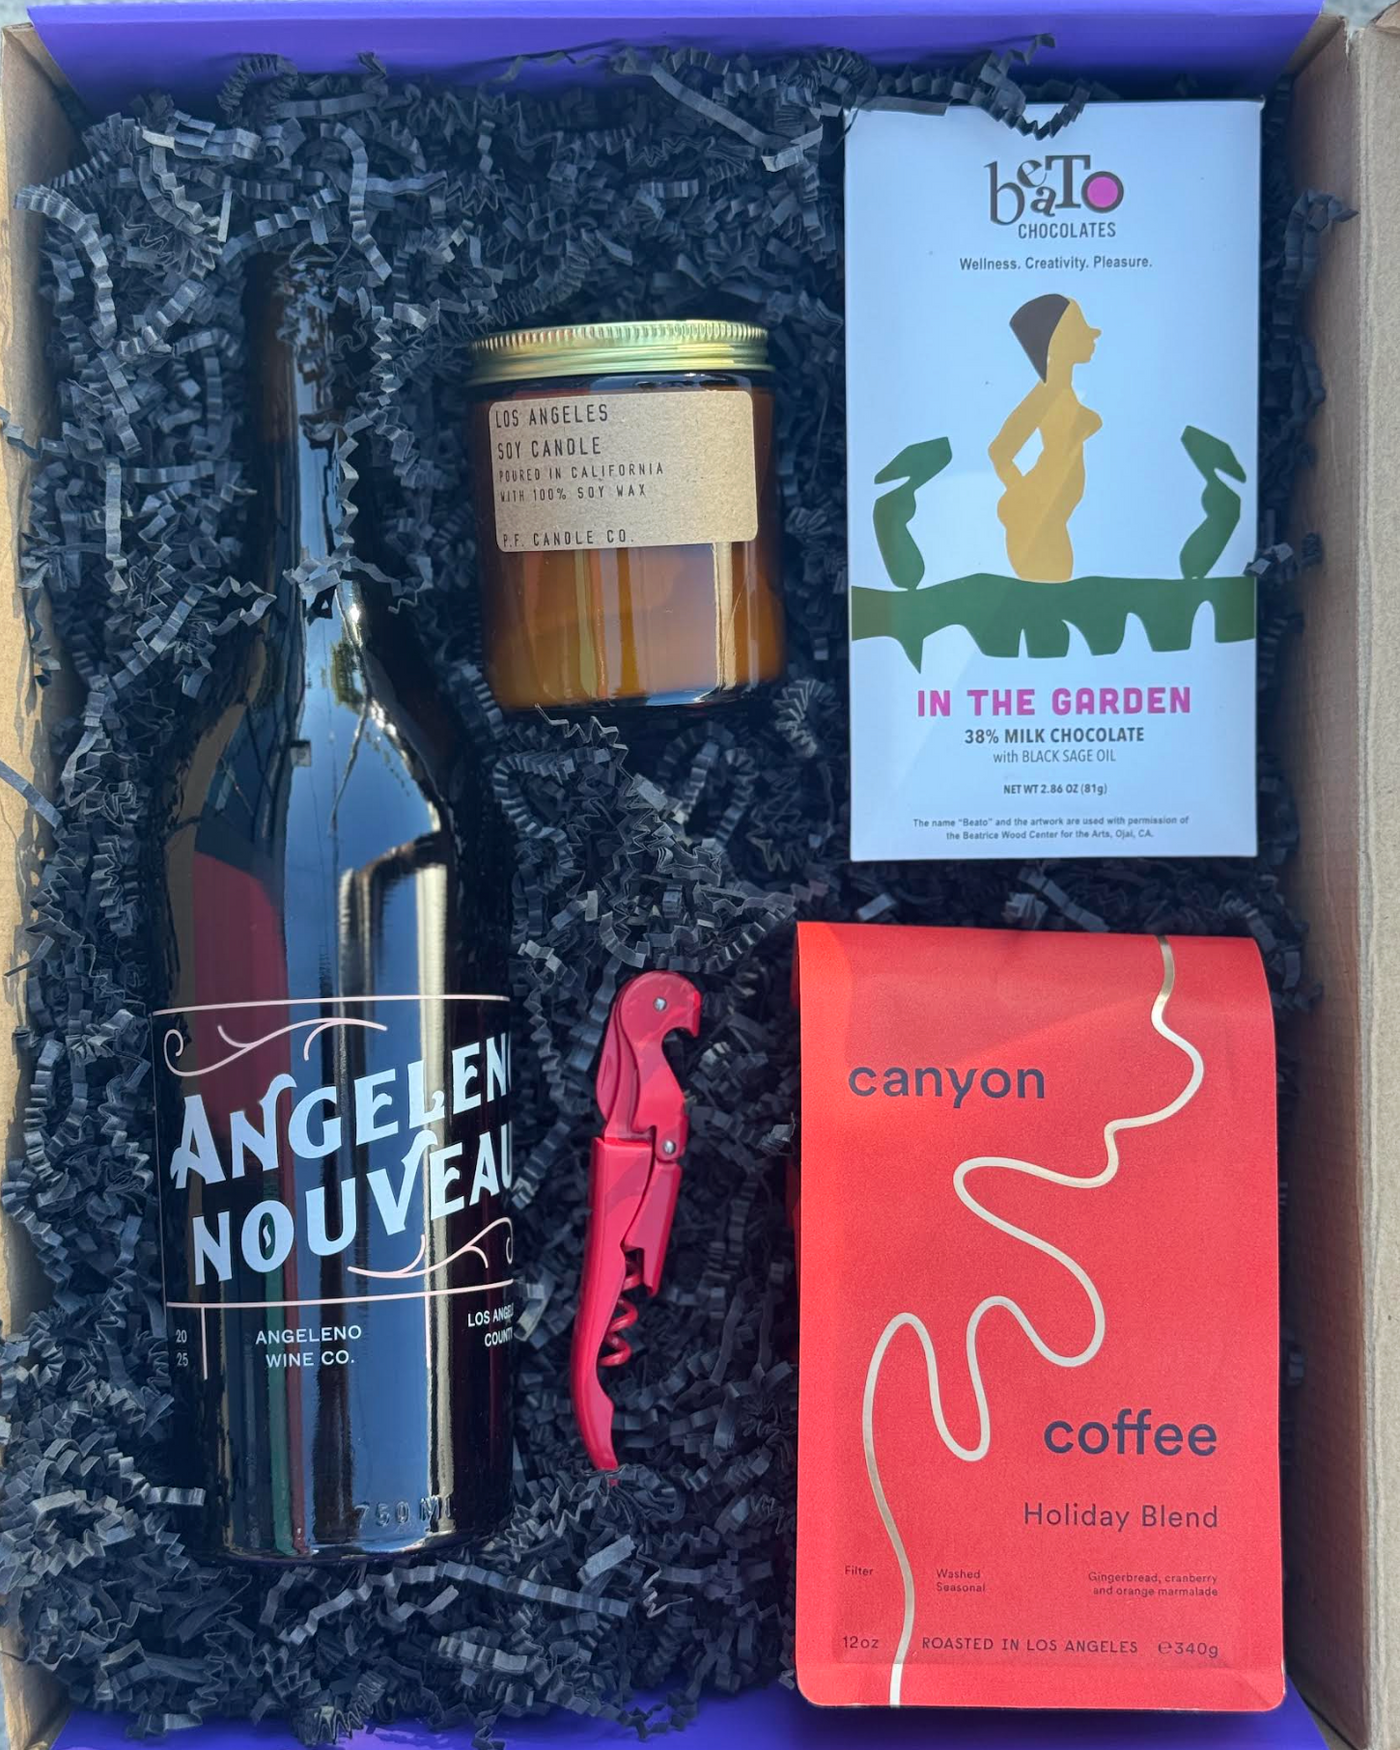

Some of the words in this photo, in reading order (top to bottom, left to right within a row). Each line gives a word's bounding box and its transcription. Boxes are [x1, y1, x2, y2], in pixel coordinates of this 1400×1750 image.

[1018, 222, 1117, 239] CHOCOLATES
[959, 257, 1021, 271] Wellness.
[1025, 256, 1089, 271] Creativity.
[1093, 255, 1153, 269] Pleasure.
[495, 409, 519, 428] LOS
[529, 403, 608, 426] ANGELES
[497, 440, 521, 460] SOY
[531, 436, 601, 458] CANDLE
[499, 469, 541, 482] POURED
[549, 467, 562, 479] IN
[571, 462, 664, 479] CALIFORNIA
[500, 489, 524, 502] WITH
[532, 487, 566, 501] 100%
[577, 485, 605, 499] SOY
[616, 483, 647, 497] WAX
[503, 533, 525, 547] P.F.
[533, 530, 594, 546] CANDLE
[606, 528, 635, 543] CO.
[917, 690, 951, 717] IN
[967, 689, 1035, 716] THE
[1052, 686, 1191, 716] GARDEN
[964, 729, 999, 744] 38%
[1004, 728, 1045, 744] MILK
[1050, 727, 1144, 744] CHOCOLATE
[993, 751, 1018, 763] with
[1022, 750, 1059, 763] BLACK
[1063, 749, 1093, 762] SAGE
[1097, 749, 1116, 762] OIL
[1003, 784, 1021, 794] NET
[1023, 784, 1038, 794] WT
[1041, 783, 1063, 794] 2.86
[1066, 783, 1078, 793] OZ
[1080, 783, 1107, 796] (81g)
[913, 818, 929, 827] The
[932, 819, 955, 827] name
[995, 818, 1011, 826] and
[1014, 818, 1028, 826] the
[1030, 817, 1063, 826] artwork
[1083, 817, 1104, 825] used
[1107, 817, 1125, 825] with
[1128, 816, 1177, 826] permission
[1179, 816, 1189, 824] of
[946, 831, 960, 840] the
[963, 831, 999, 839] Beatrice
[1001, 830, 1026, 839] Wood
[1029, 830, 1058, 839] Center
[1061, 830, 1073, 838] for
[1075, 830, 1089, 838] the
[1091, 830, 1113, 839] Arts,
[1116, 829, 1136, 839] Ojai,
[848, 1066, 1045, 1109] canyon
[170, 1032, 512, 1189] ANGELEN
[468, 1310, 490, 1328] LOS
[175, 1329, 187, 1344] 20
[255, 1325, 362, 1345] ANGELENO
[176, 1352, 189, 1368] 25
[265, 1352, 314, 1368] WINE
[321, 1350, 355, 1365] CO.
[1044, 1408, 1217, 1456] coffee
[1024, 1502, 1130, 1532] Holiday
[1141, 1504, 1219, 1528] Blend
[844, 1565, 874, 1577] Filter
[936, 1568, 981, 1580] Washed
[1088, 1571, 1162, 1584] Gingerbread,
[1164, 1573, 1218, 1585] cranberry
[936, 1582, 986, 1594] Seasonal
[1093, 1586, 1113, 1596] and
[1116, 1587, 1155, 1598] orange
[1157, 1587, 1218, 1597] marmalade
[842, 1635, 879, 1650] 12oz
[922, 1636, 994, 1651] ROASTED
[1002, 1638, 1018, 1651] IN
[1026, 1638, 1057, 1653] LOS
[1065, 1639, 1138, 1654] ANGELES
